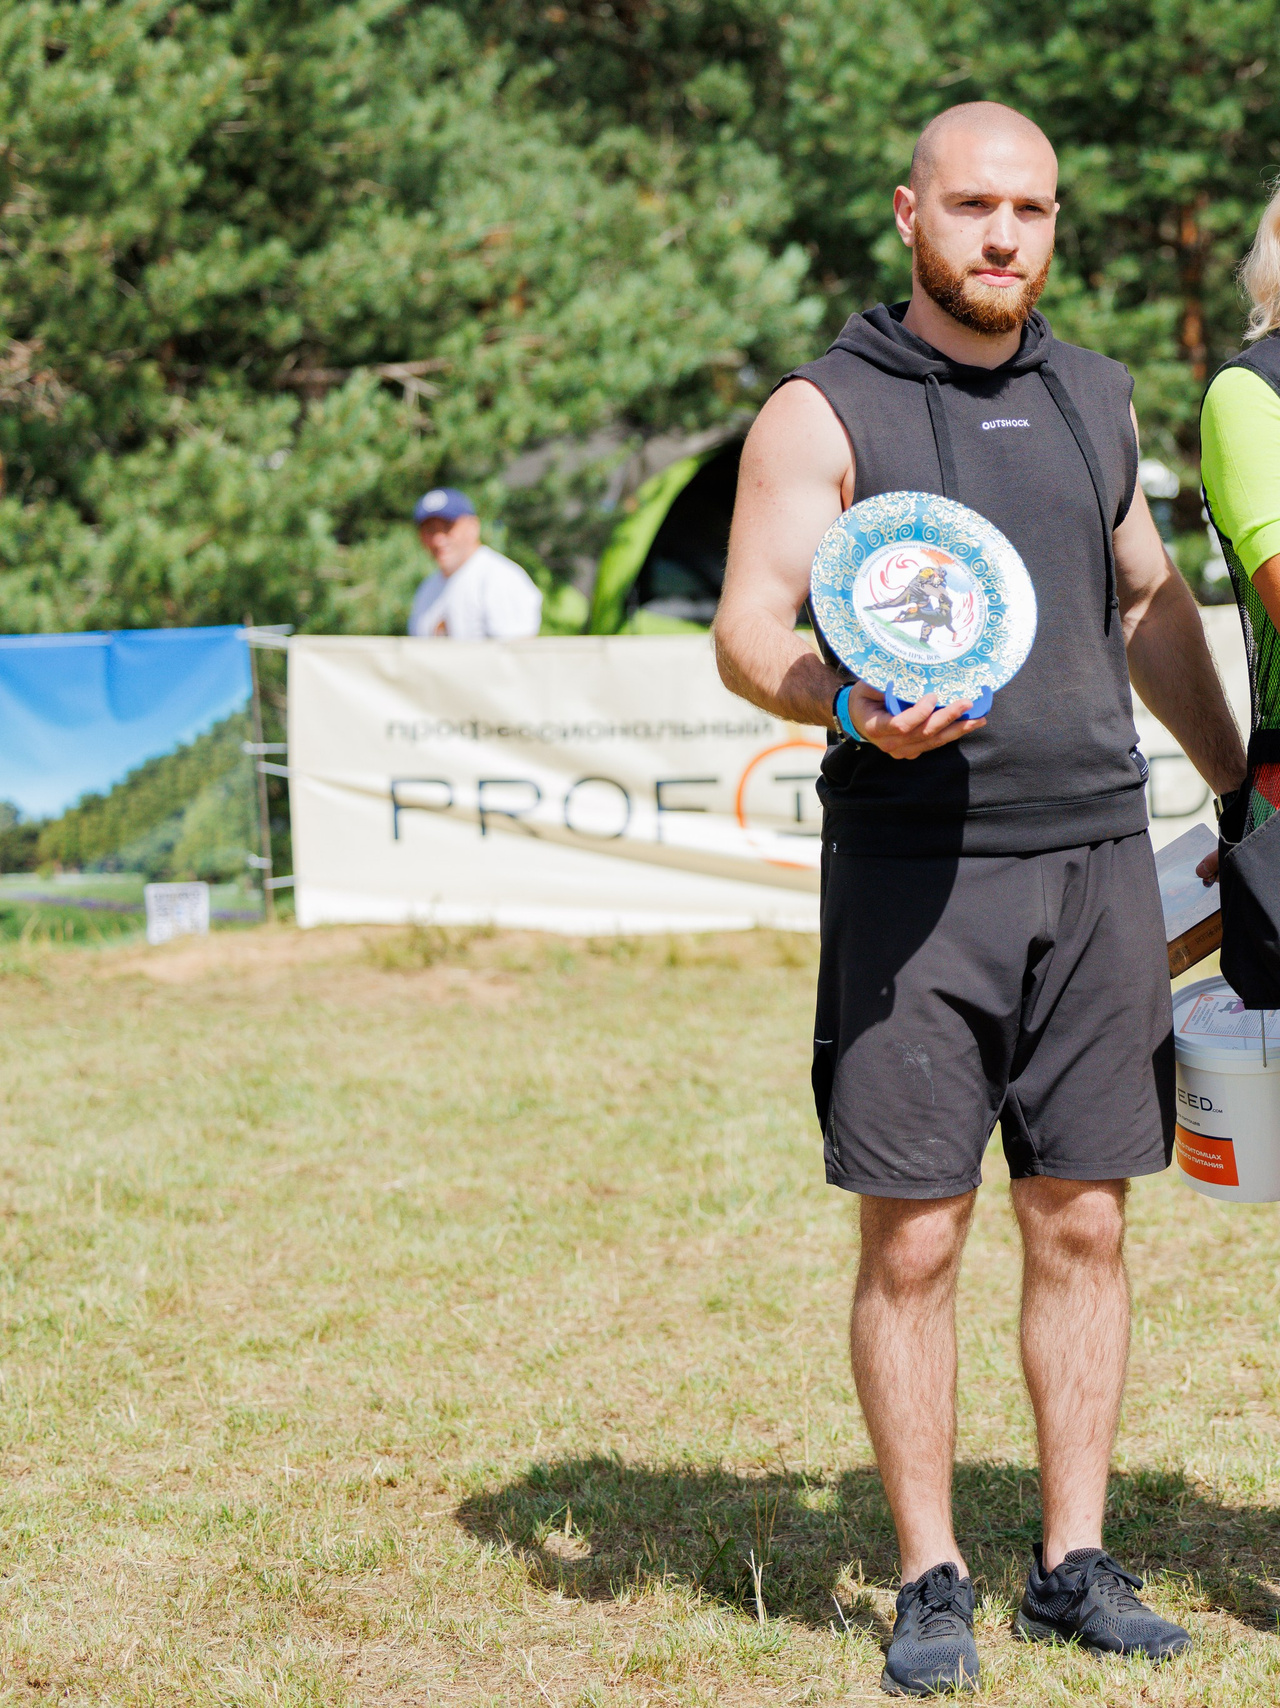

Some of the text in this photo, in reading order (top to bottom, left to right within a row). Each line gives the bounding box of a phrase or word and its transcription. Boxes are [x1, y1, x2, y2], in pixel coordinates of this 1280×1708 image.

[982, 419, 1030, 430] OUTSHOCK
[386, 714, 776, 743] профессиональный
[1191, 1156, 1225, 1170] ПИТАНИЯ
